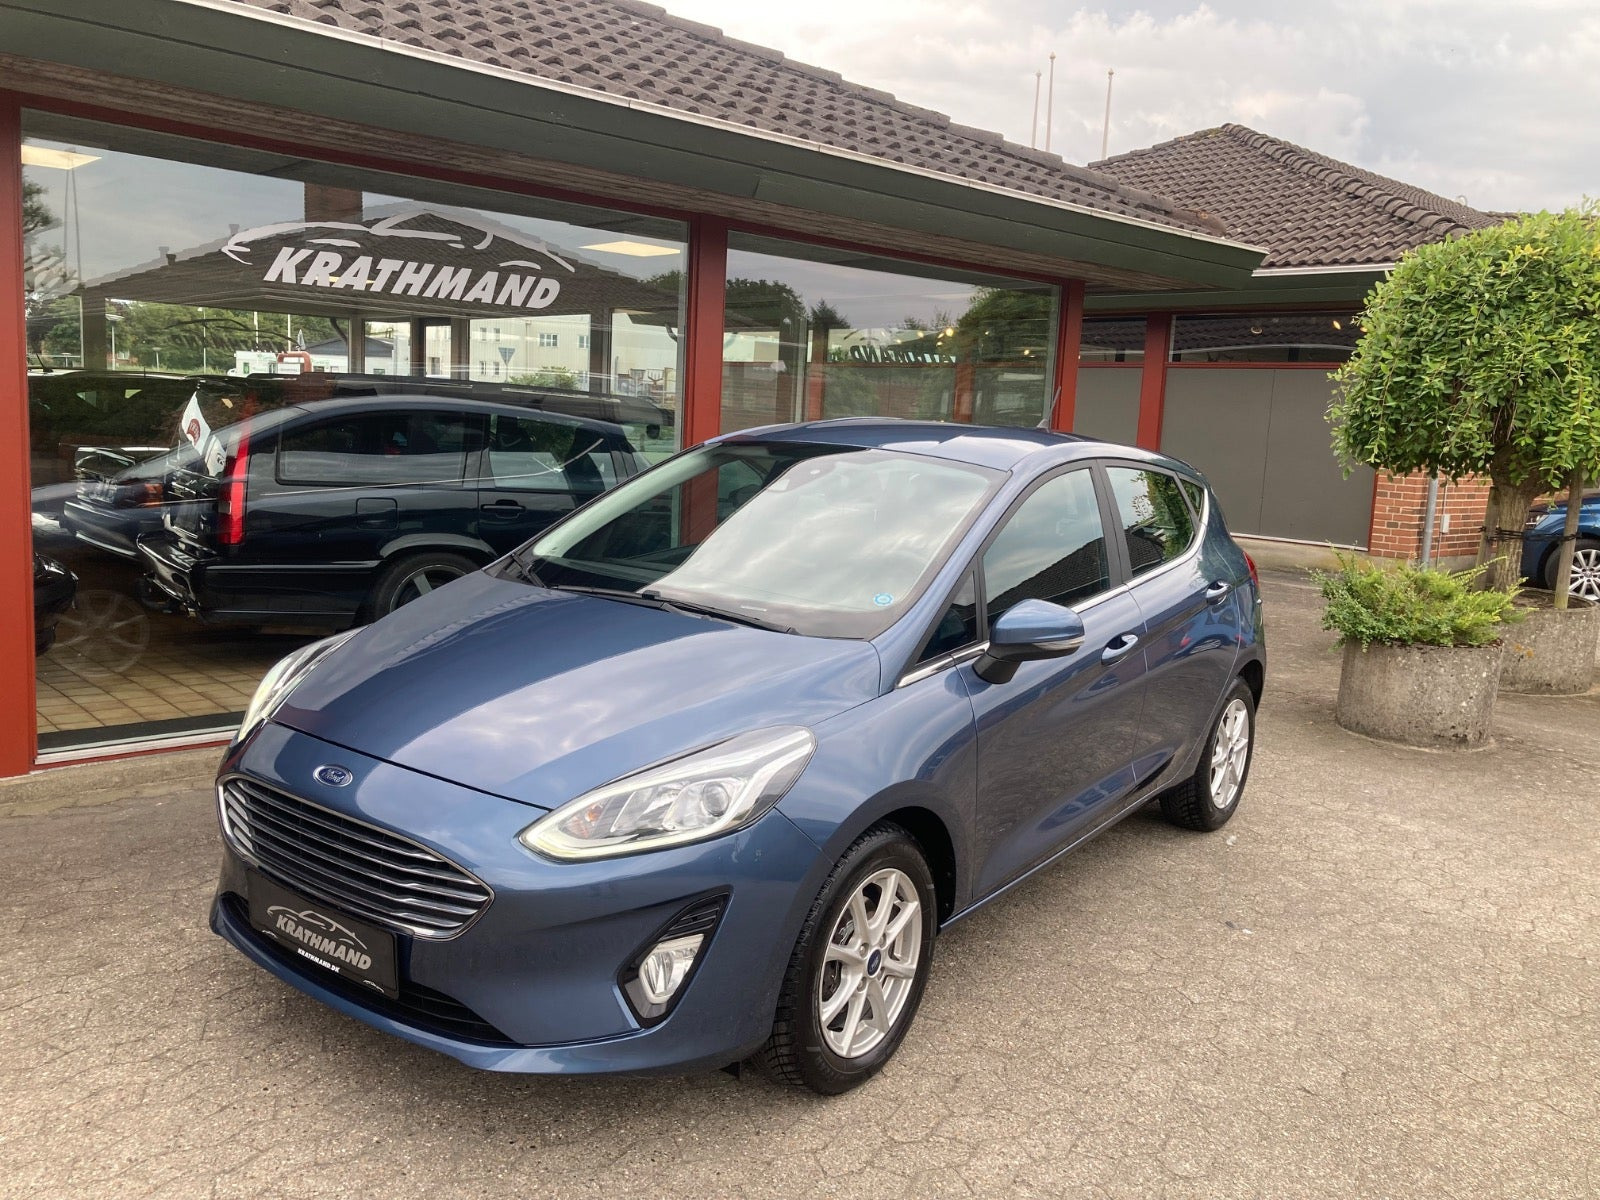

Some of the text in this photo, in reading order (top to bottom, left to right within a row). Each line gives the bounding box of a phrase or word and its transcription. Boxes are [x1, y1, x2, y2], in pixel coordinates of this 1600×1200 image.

[263, 247, 560, 309] KRATHMAND
[276, 914, 372, 970] KRATHMAND
[297, 948, 340, 973] KRATHMAND.DK
